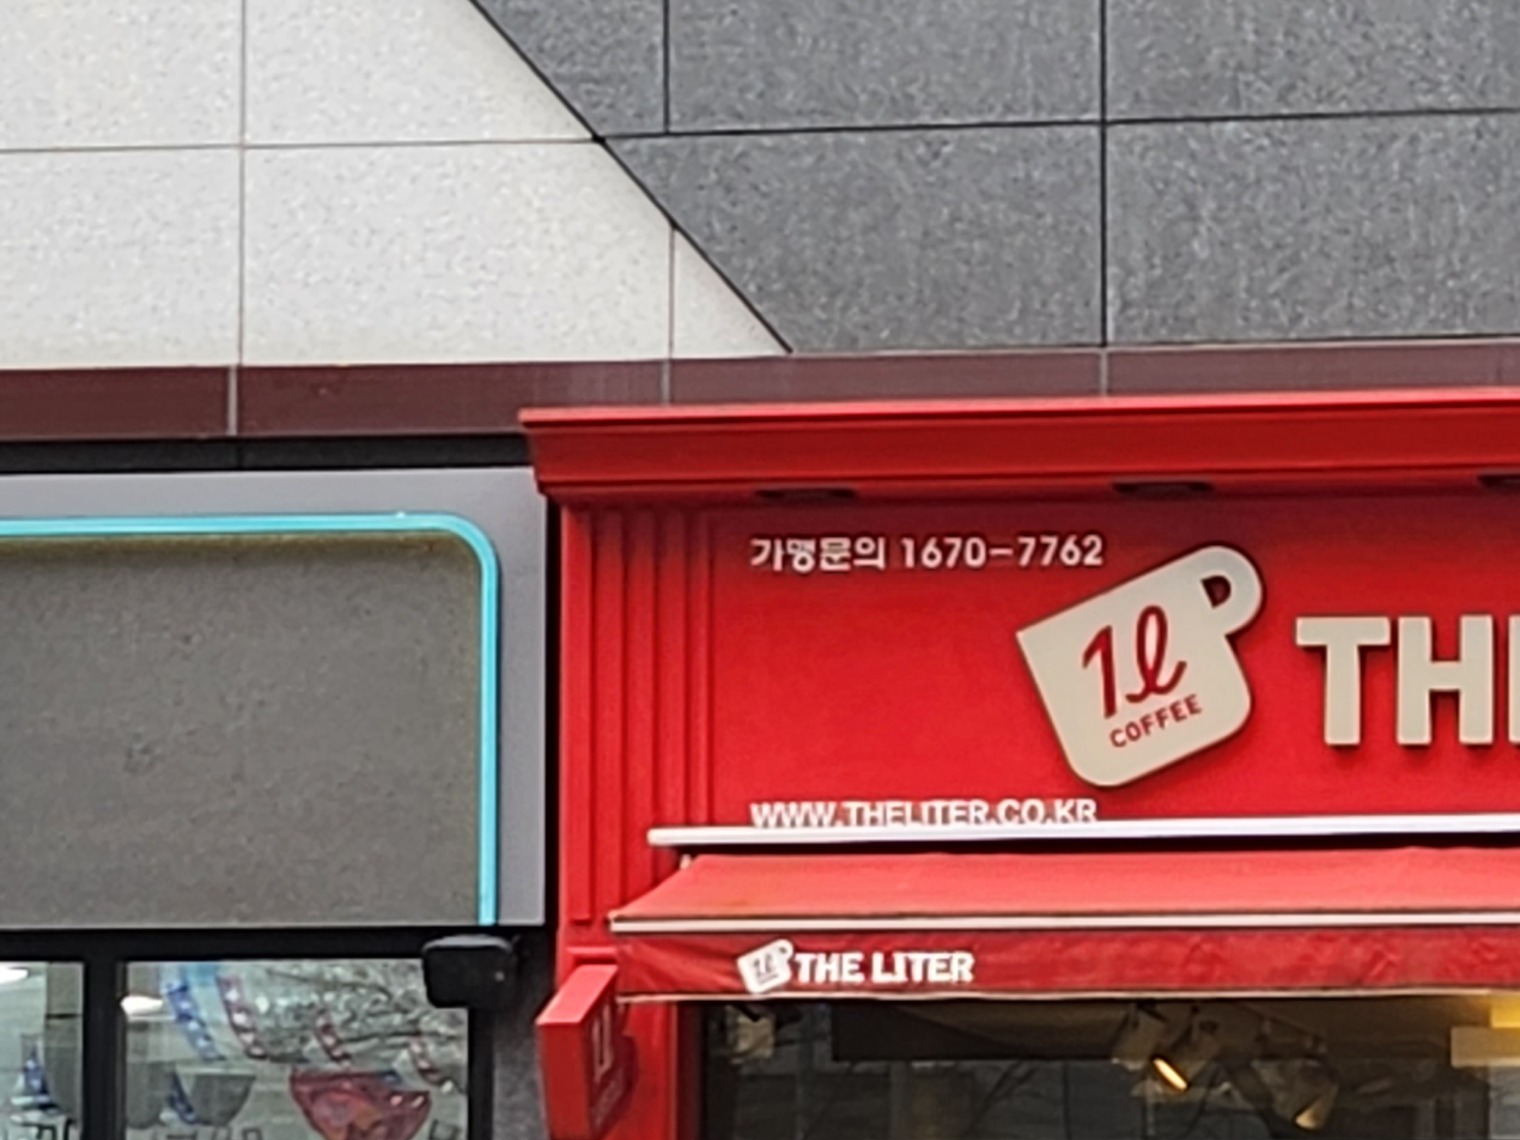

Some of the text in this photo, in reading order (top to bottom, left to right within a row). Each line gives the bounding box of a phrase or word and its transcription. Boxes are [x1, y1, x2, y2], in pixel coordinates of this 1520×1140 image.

[750, 535, 1104, 573] 가맹문의 1670-7762
[1109, 693, 1202, 749] COFFEE
[750, 799, 1098, 829] WWW.THELITER.CO.KR
[795, 951, 975, 984] THE LITER
